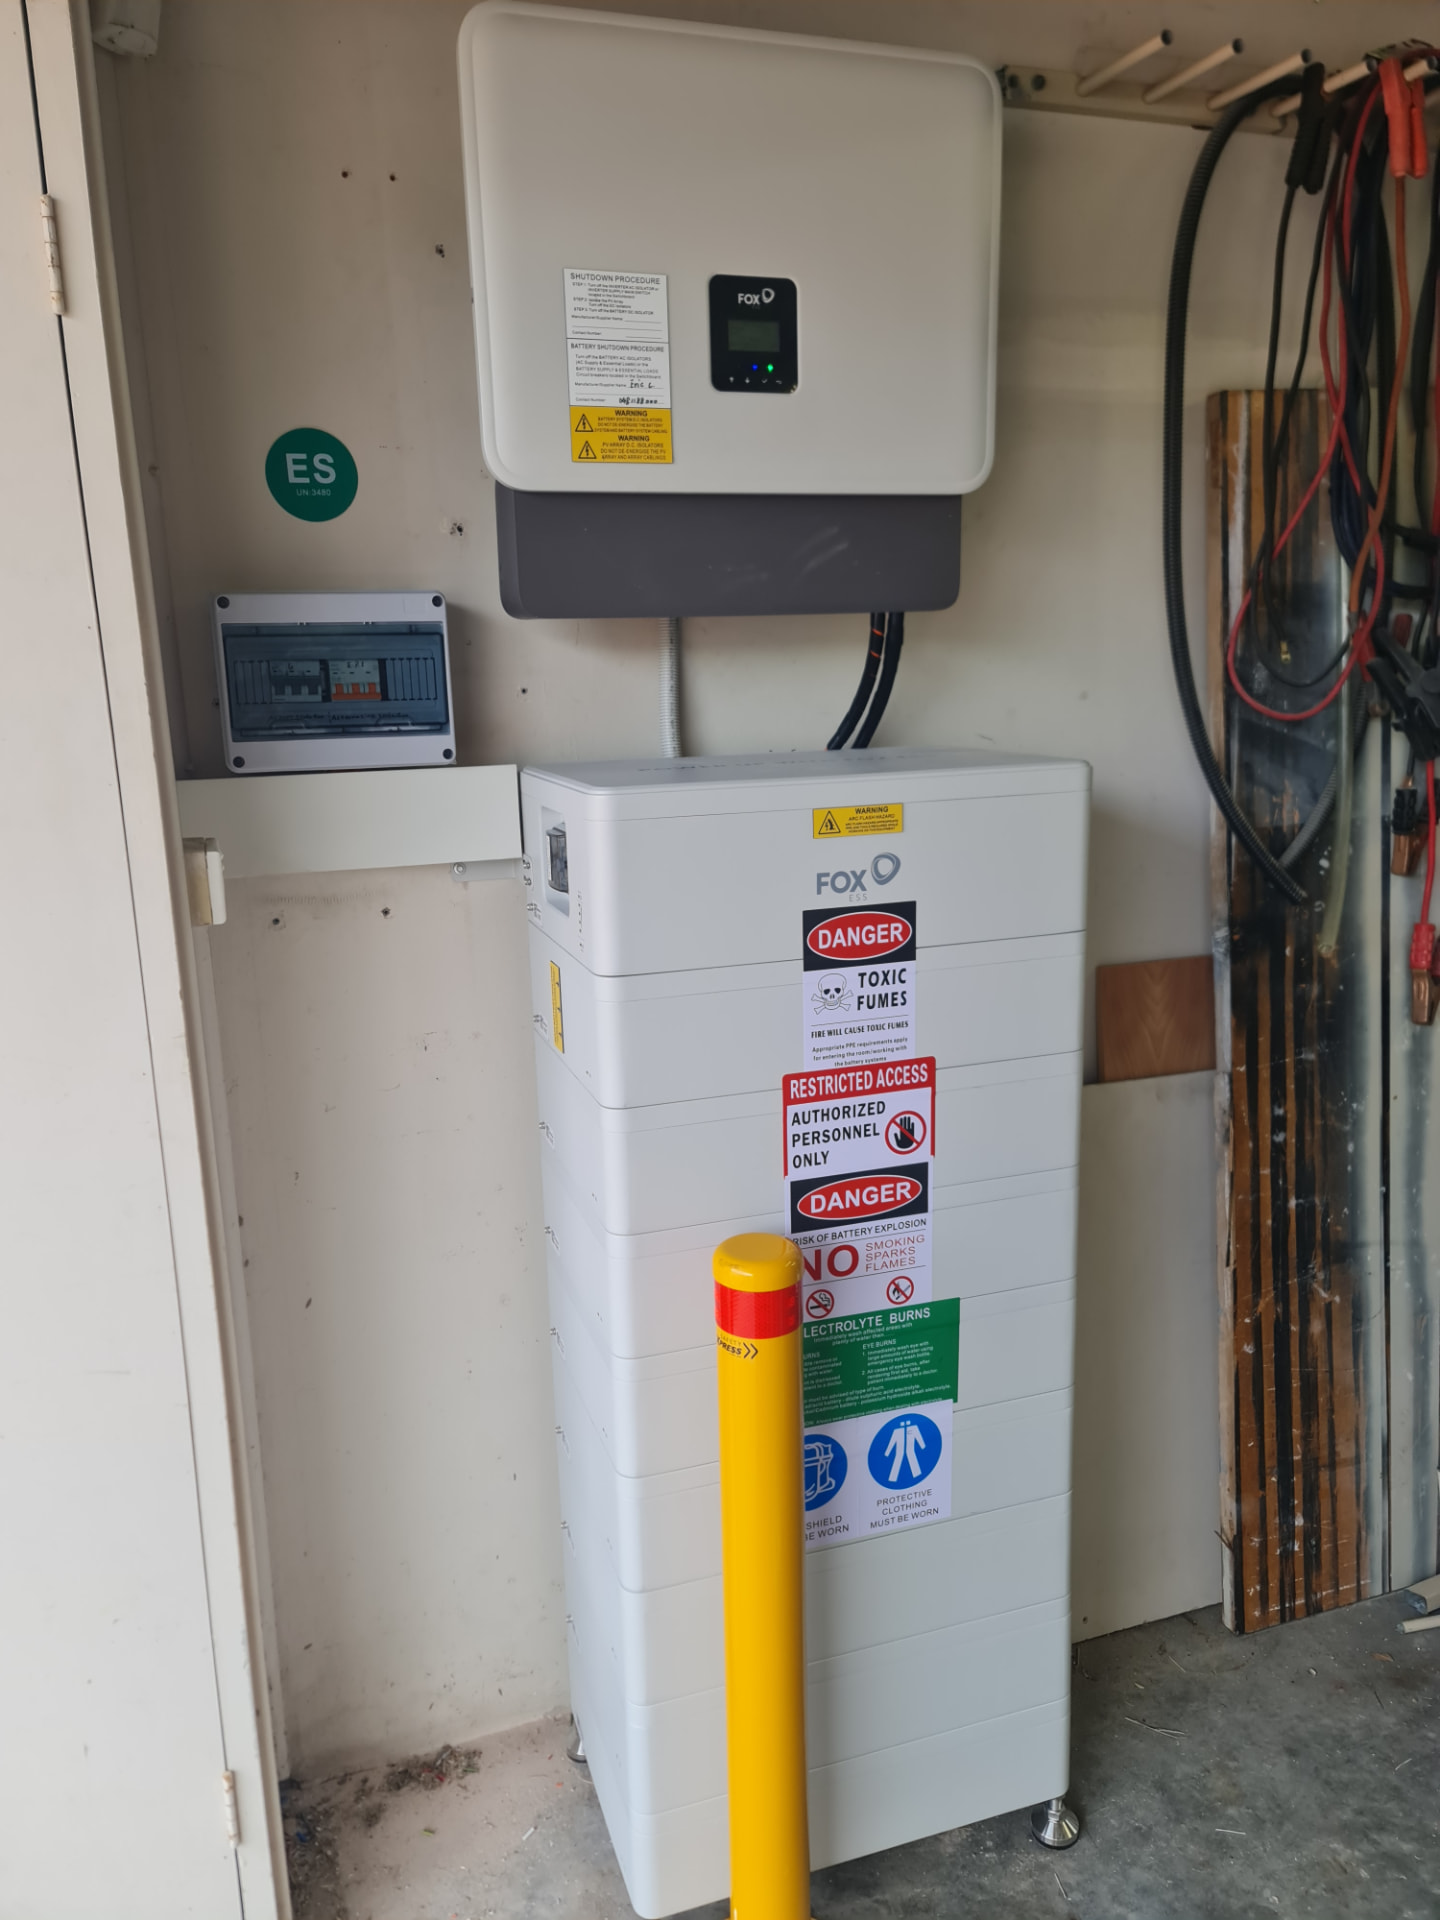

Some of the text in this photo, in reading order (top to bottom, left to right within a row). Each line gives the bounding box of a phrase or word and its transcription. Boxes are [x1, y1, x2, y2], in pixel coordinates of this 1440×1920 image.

[571, 273, 660, 284] SHUTDOWN PROCEDURE
[738, 293, 760, 304] FOX
[286, 453, 336, 484] ES
[816, 870, 867, 895] FOX
[818, 923, 904, 950] DANGER
[858, 968, 907, 988] TOXIC
[857, 991, 907, 1011] FUMES
[811, 1021, 909, 1038] FIRE WILL CAUSE TOXIC FUMES
[812, 1044, 844, 1053] Appropriate
[857, 1039, 892, 1048] requirements
[822, 1052, 845, 1060] entering
[790, 1064, 928, 1099] RESTRICTED ACCESS
[792, 1100, 886, 1126] AUTHORIZED
[792, 1123, 880, 1148] PERSONNEL
[792, 1151, 829, 1169] ONLY
[810, 1182, 912, 1214] DANGER
[793, 1218, 927, 1246] RISK OF BATTERY EXPLOSION
[866, 1234, 925, 1251] SMOKING
[804, 1245, 859, 1281] NO
[866, 1247, 915, 1262] SPARKS
[866, 1256, 915, 1272] FLAMES
[804, 1307, 930, 1338] LECTROLYTE BURNS
[876, 1339, 896, 1347] BURNS
[876, 1489, 932, 1506] PROTECTIVE
[882, 1499, 928, 1516] CLOTHING
[806, 1515, 842, 1530] SHIELD
[870, 1507, 939, 1529] MUST BE WORN
[818, 1525, 850, 1538] WORN
